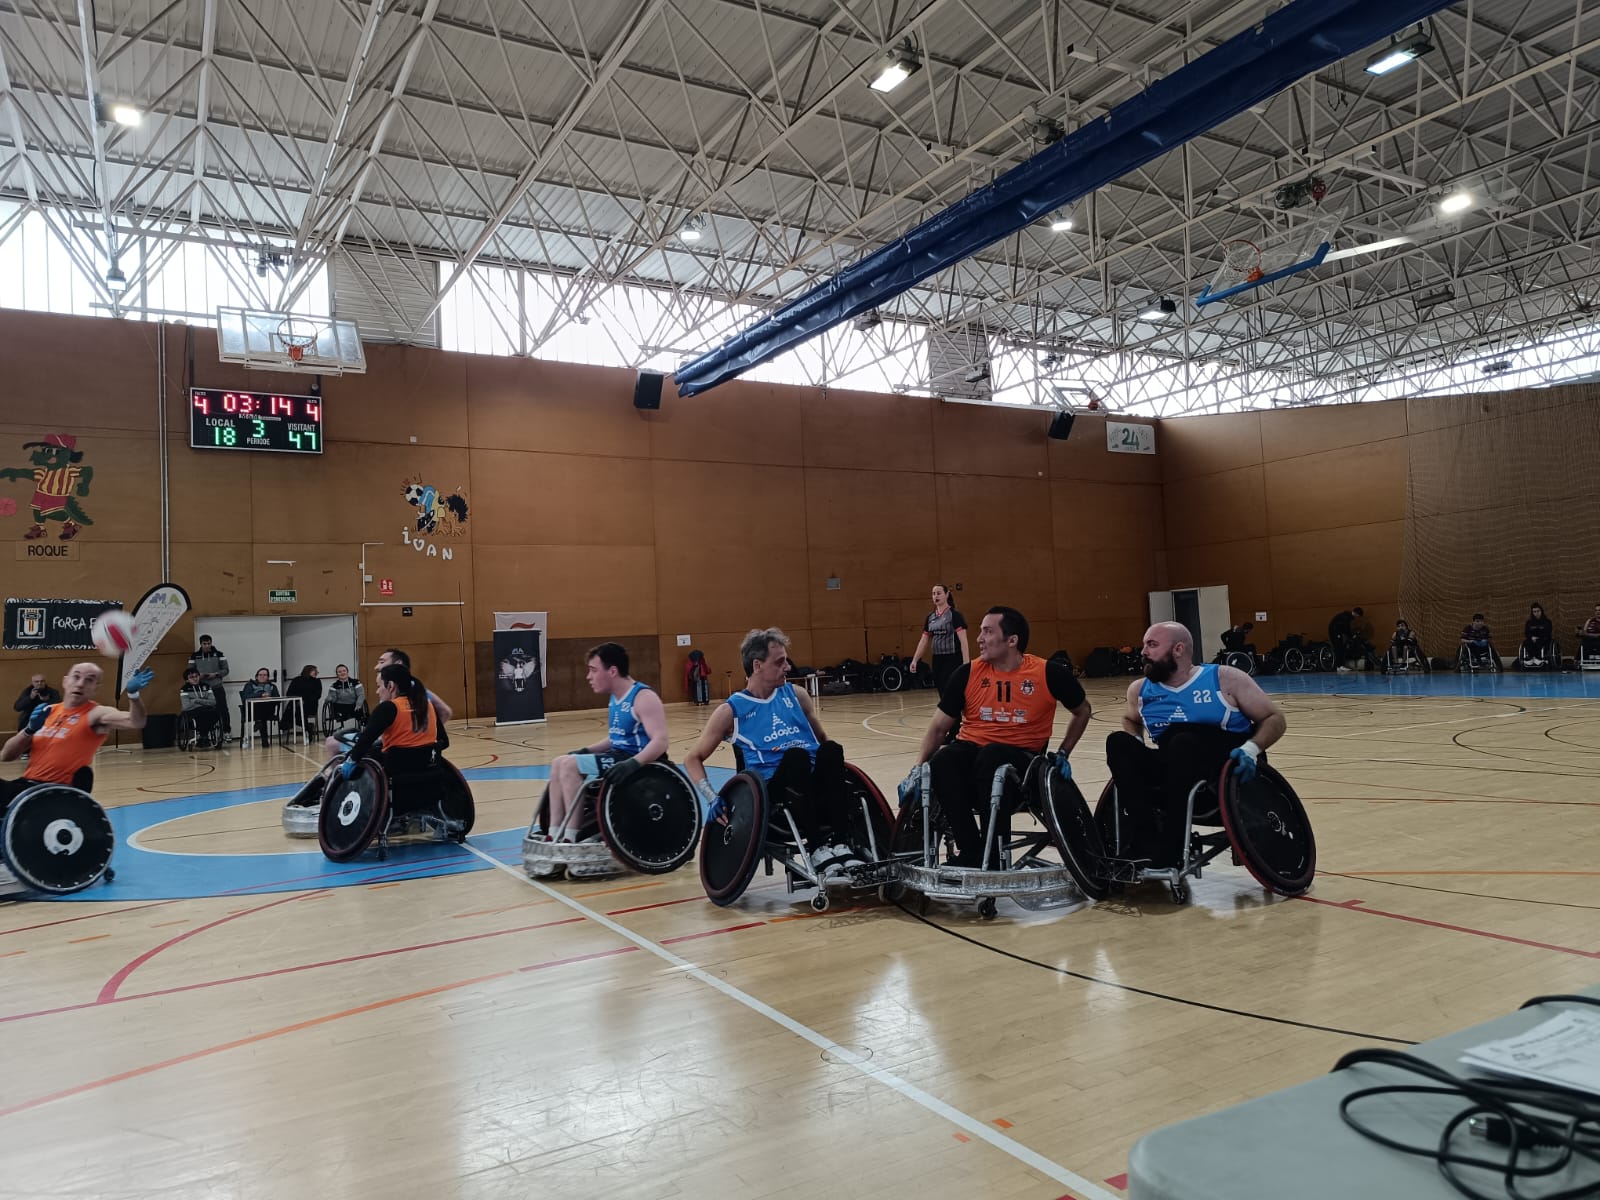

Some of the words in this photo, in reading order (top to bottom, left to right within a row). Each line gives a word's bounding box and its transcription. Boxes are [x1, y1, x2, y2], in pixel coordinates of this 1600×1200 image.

[194, 395, 208, 415] 4
[306, 403, 319, 422] 4
[205, 417, 236, 428] LOCAL
[252, 419, 265, 438] 3
[287, 422, 316, 432] VISITANT
[214, 426, 236, 446] 18
[288, 430, 316, 450] 47
[28, 545, 69, 557] ROQUE
[52, 616, 87, 632] FORÇA
[996, 680, 1012, 703] 11
[1192, 689, 1212, 704] 22
